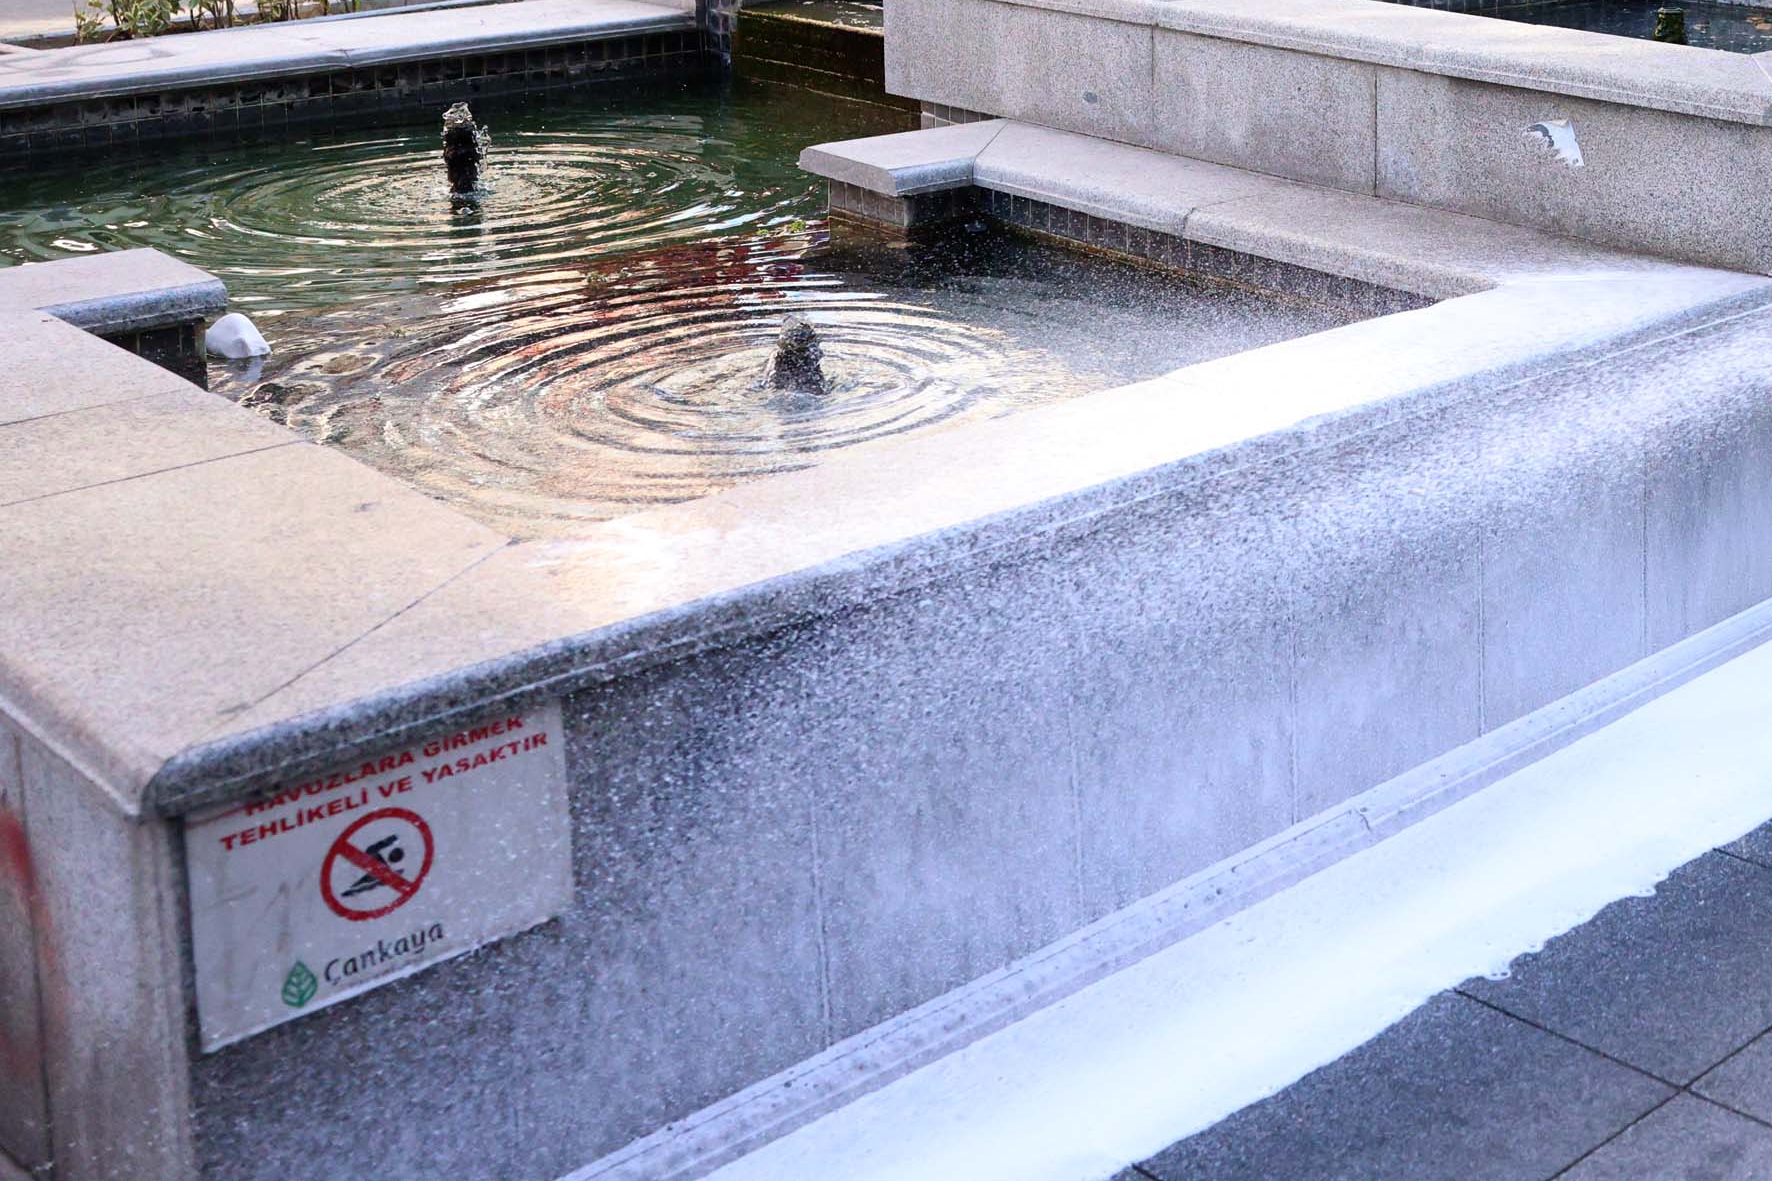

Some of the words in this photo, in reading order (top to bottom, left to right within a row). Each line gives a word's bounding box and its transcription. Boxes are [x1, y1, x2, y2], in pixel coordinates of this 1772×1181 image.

[219, 787, 368, 852] TEHLİKELİ
[378, 775, 413, 799] VE
[421, 732, 548, 784] YASAKTIR
[324, 922, 444, 986] Çankaya
